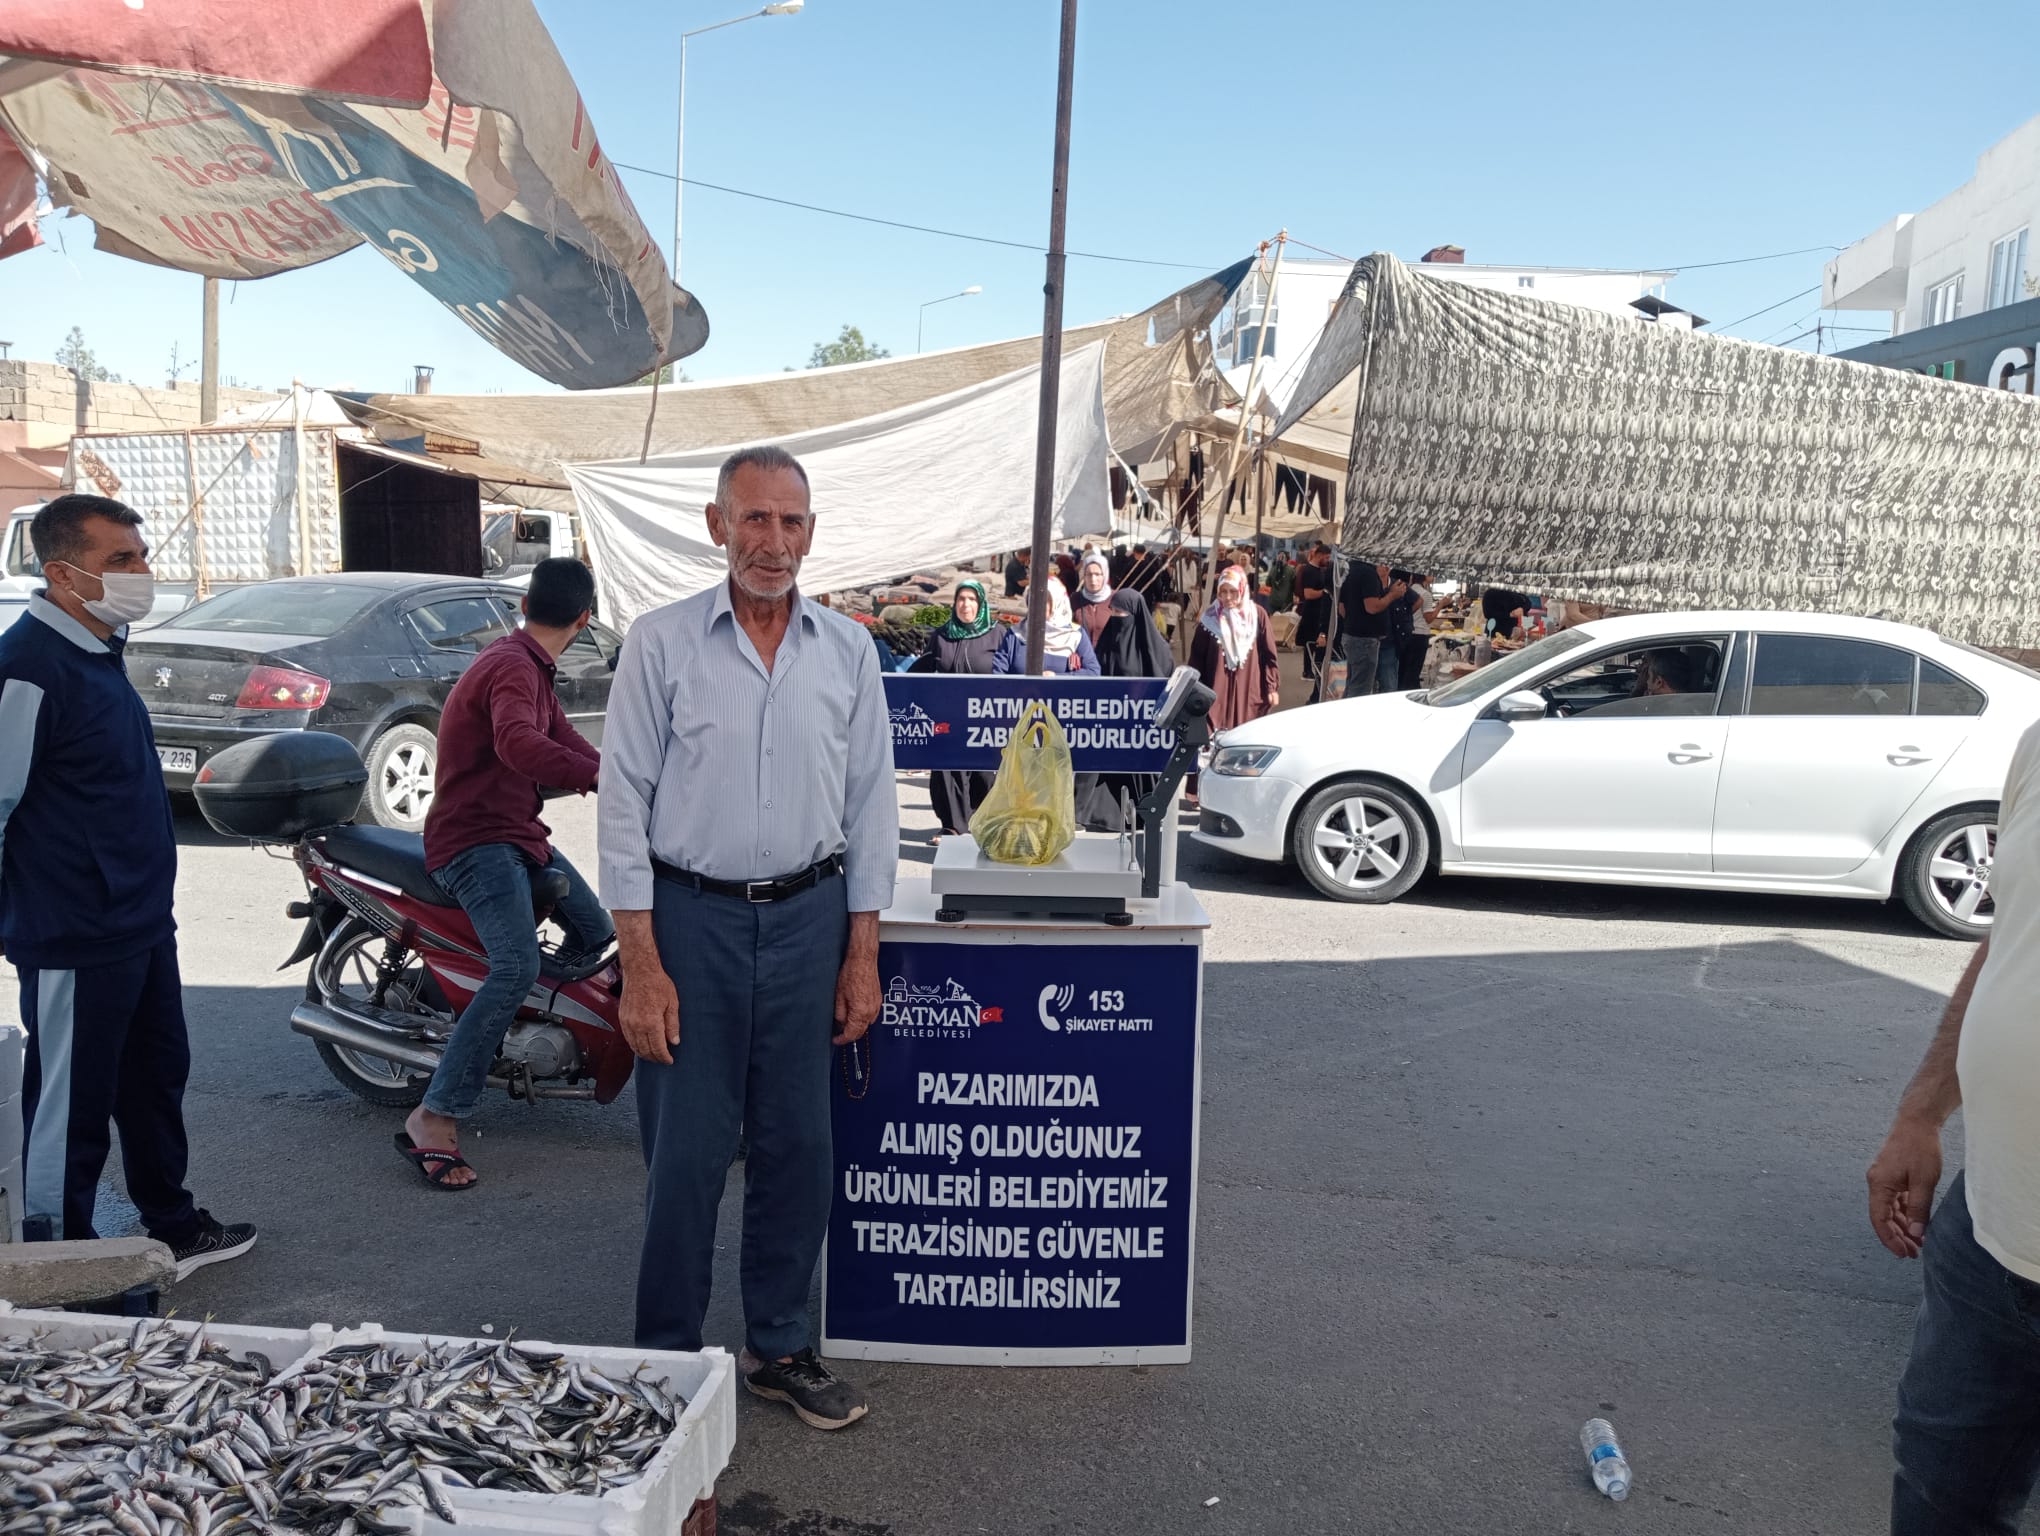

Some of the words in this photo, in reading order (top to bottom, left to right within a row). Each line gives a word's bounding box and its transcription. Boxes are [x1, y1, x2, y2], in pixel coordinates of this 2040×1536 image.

[1058, 694, 1157, 720] BELEDİYE
[890, 721, 935, 737] TMAN
[171, 751, 192, 768] 236
[1088, 990, 1125, 1012] 153
[881, 1003, 982, 1028] BATMAN
[1065, 1015, 1116, 1034] ŞİKAYET
[1118, 1018, 1153, 1032] HATTI
[894, 1027, 972, 1039] BELEDİYESİ
[917, 1072, 1100, 1107] PAZARIMIZDA
[879, 1121, 963, 1164] ALMIŞ
[970, 1117, 1142, 1159] OLDUĞUNUZ
[844, 1164, 981, 1207] ÜRÜNLERİ
[988, 1169, 1169, 1209] BELEDİYEMİZ
[852, 1217, 1030, 1259] TERAZİSİNDE
[1037, 1220, 1165, 1260] GÜVENLE
[893, 1268, 1121, 1309] TARTABİLİRSİNİZ
